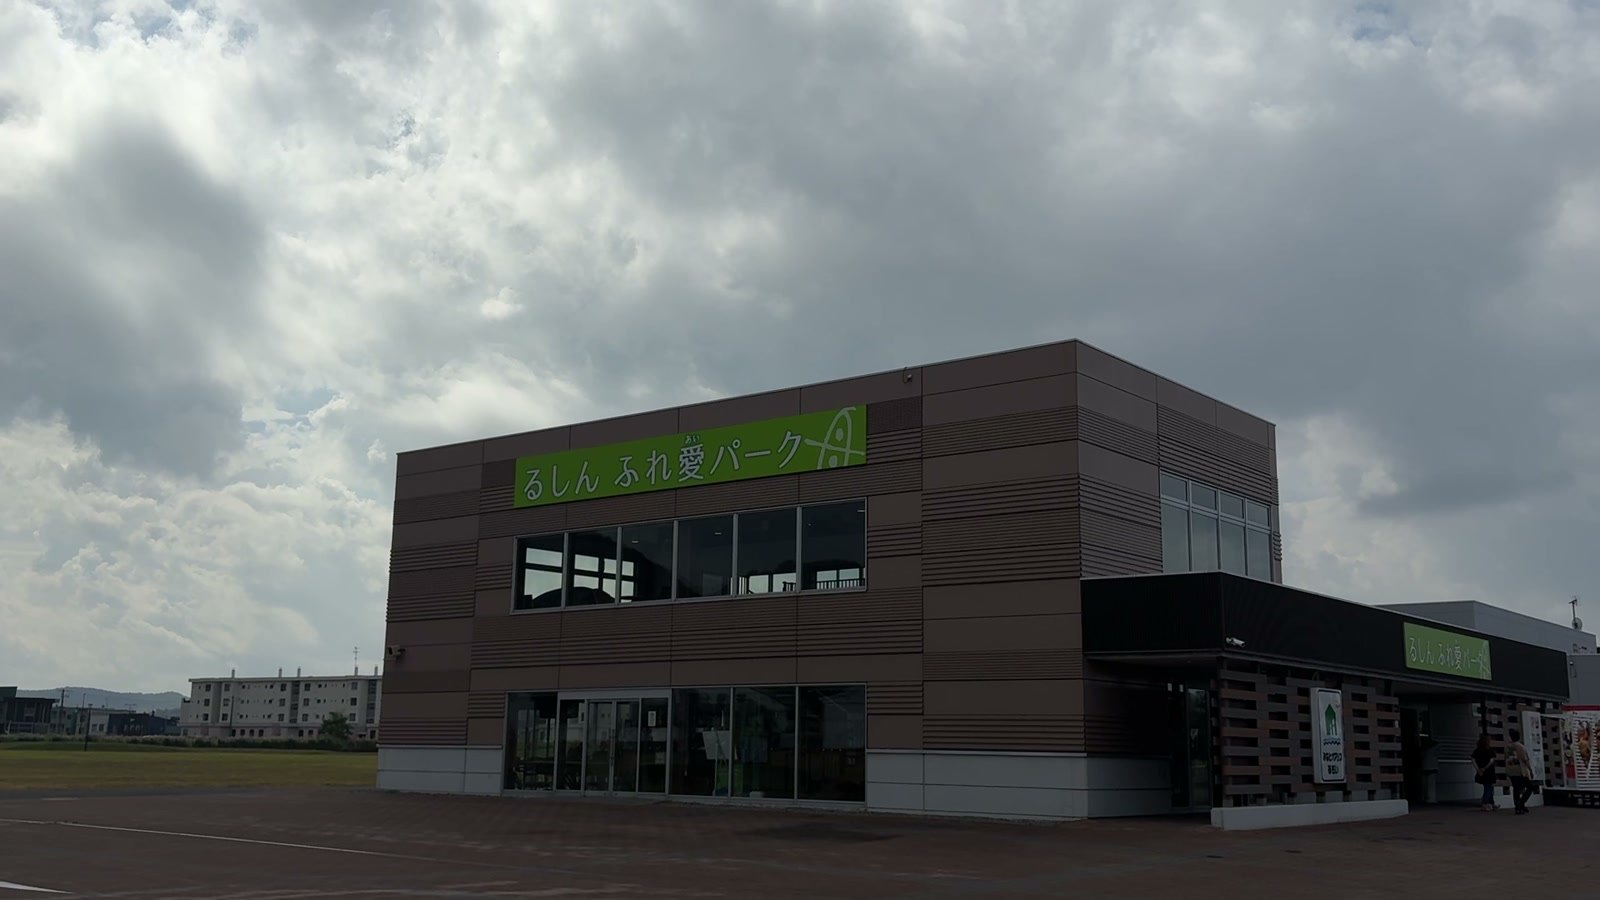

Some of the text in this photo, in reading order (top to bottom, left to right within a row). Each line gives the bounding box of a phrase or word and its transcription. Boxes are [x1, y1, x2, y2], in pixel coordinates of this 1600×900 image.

[523, 430, 803, 501] るしん ふれ愛パーク
